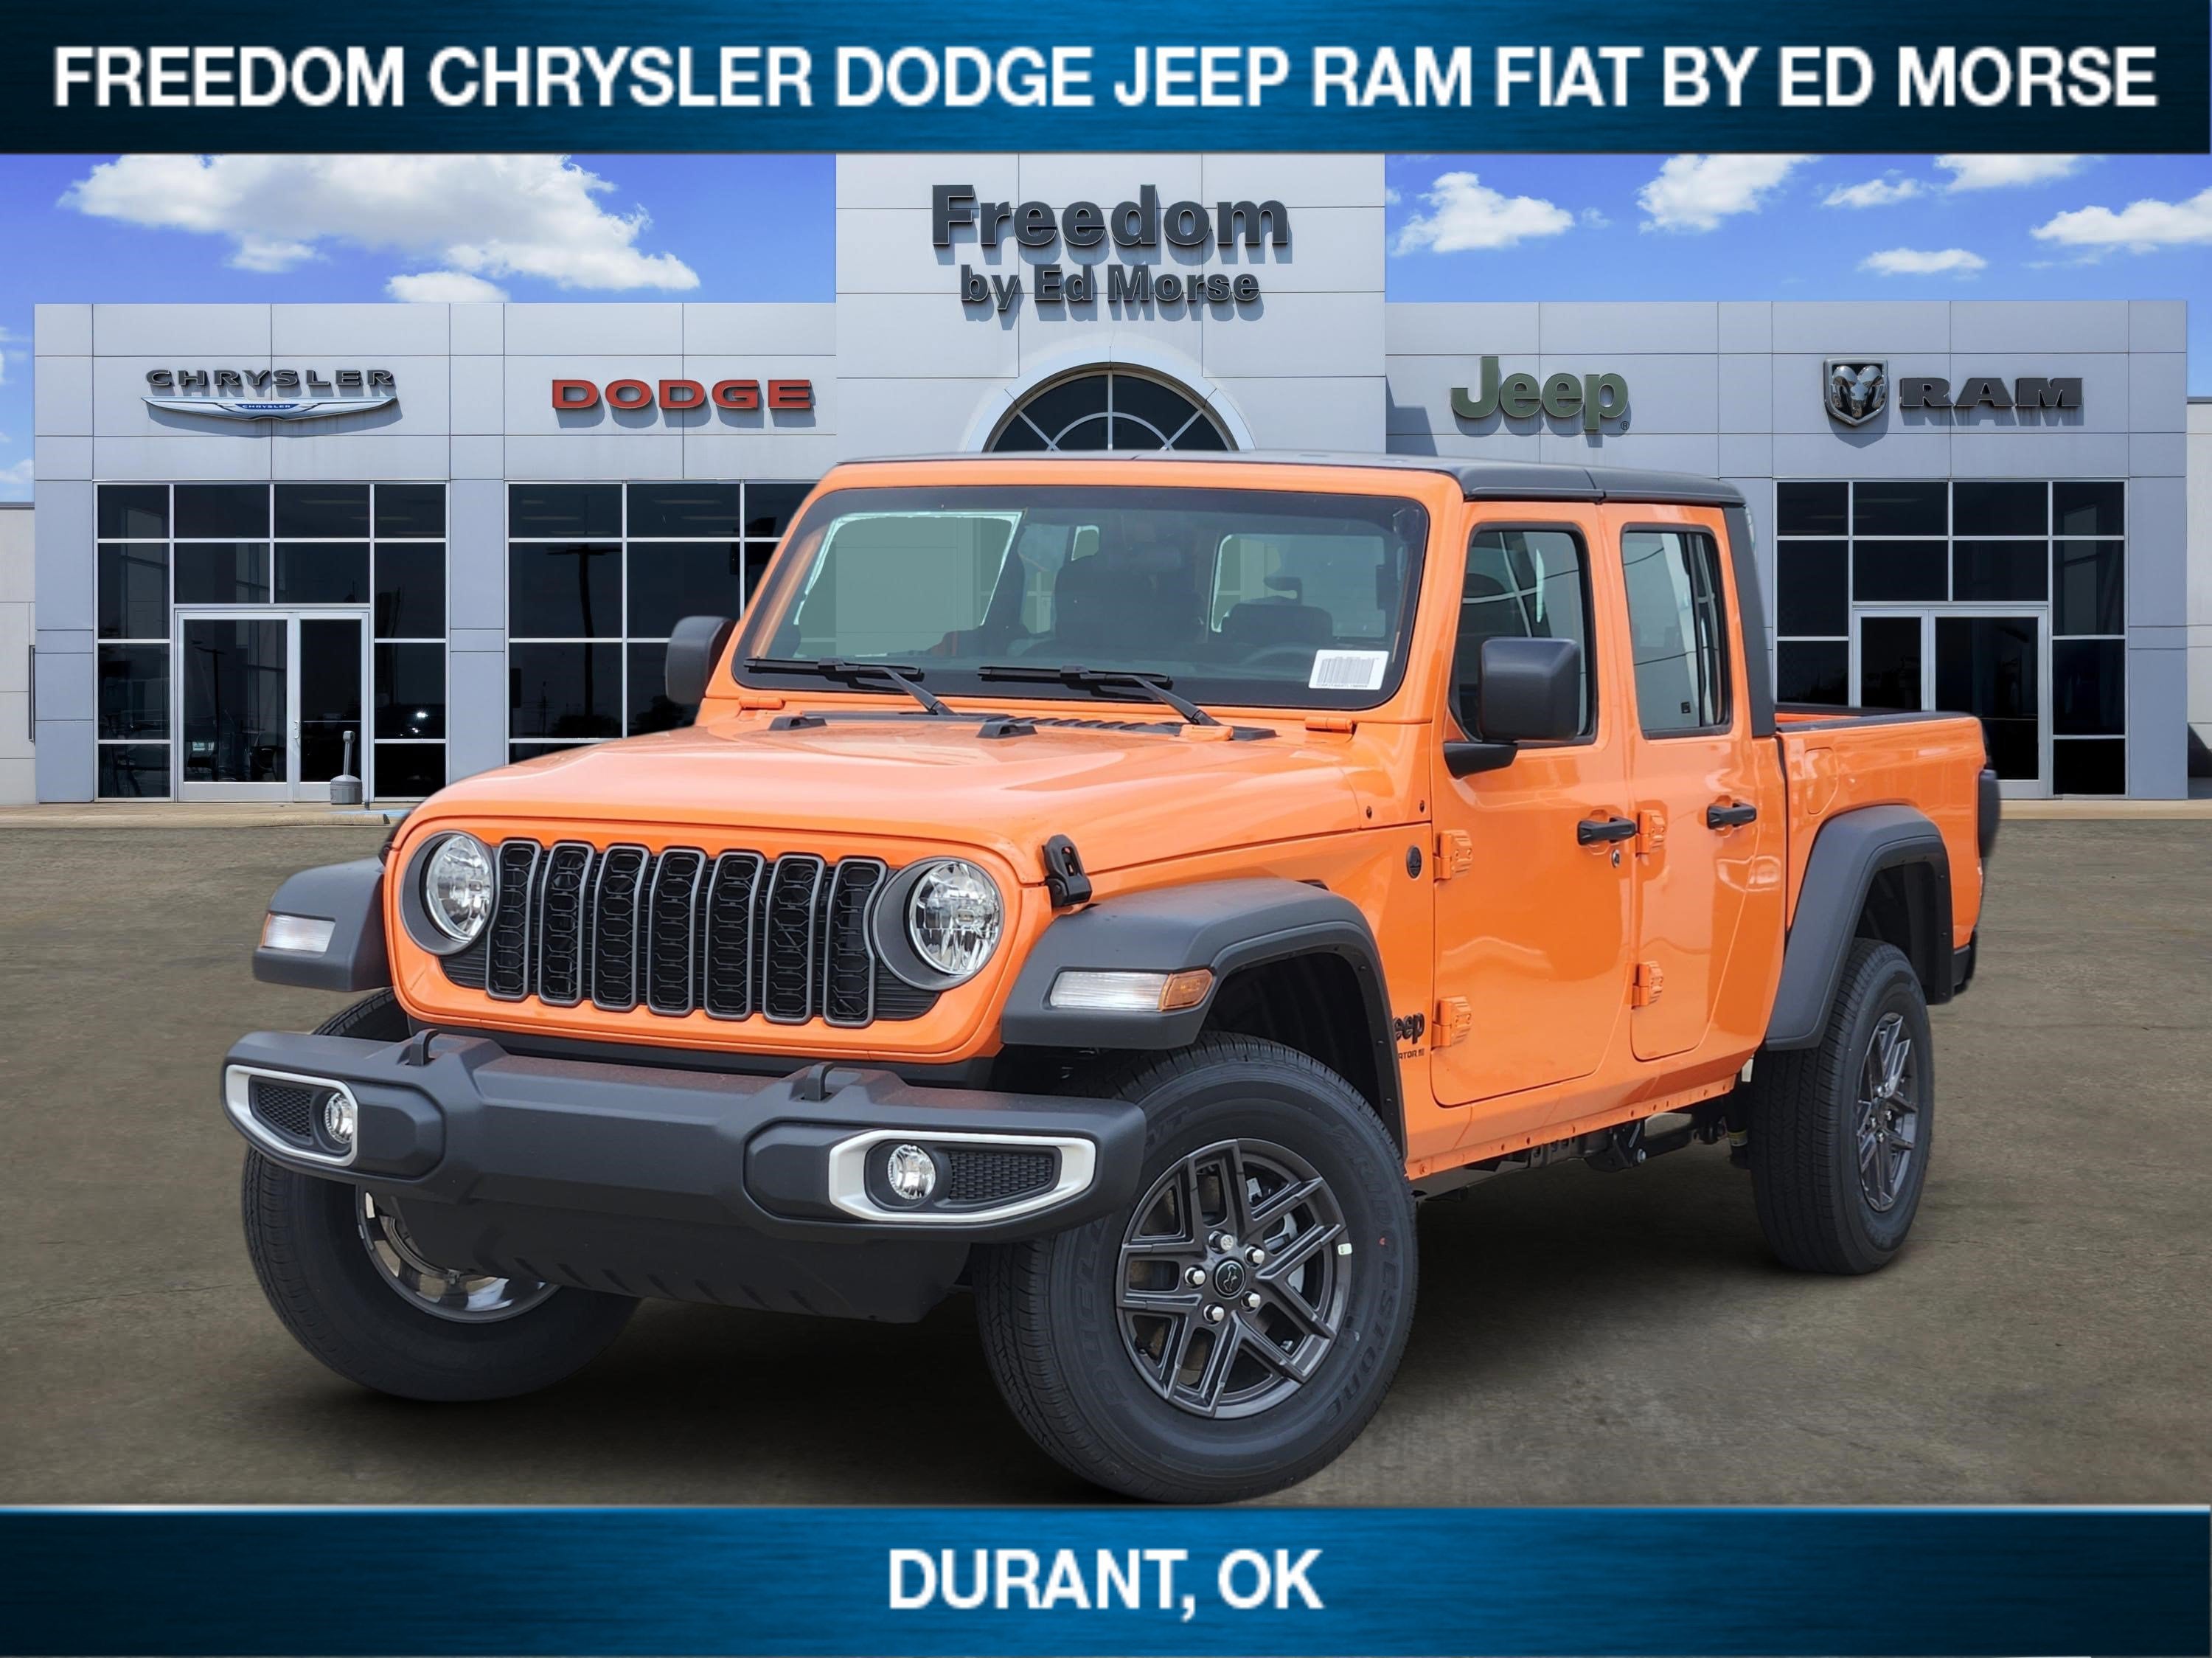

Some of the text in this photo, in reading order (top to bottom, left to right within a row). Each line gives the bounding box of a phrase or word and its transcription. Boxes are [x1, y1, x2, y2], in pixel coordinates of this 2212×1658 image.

[932, 184, 1289, 246] Freedom
[961, 264, 1260, 311] by Ed Morse
[145, 369, 394, 386] CHRYSLER
[1450, 355, 1629, 430] Jeep
[1899, 377, 2084, 408] RAM
[552, 378, 812, 409] DODGE
[1393, 1013, 1425, 1044] eep
